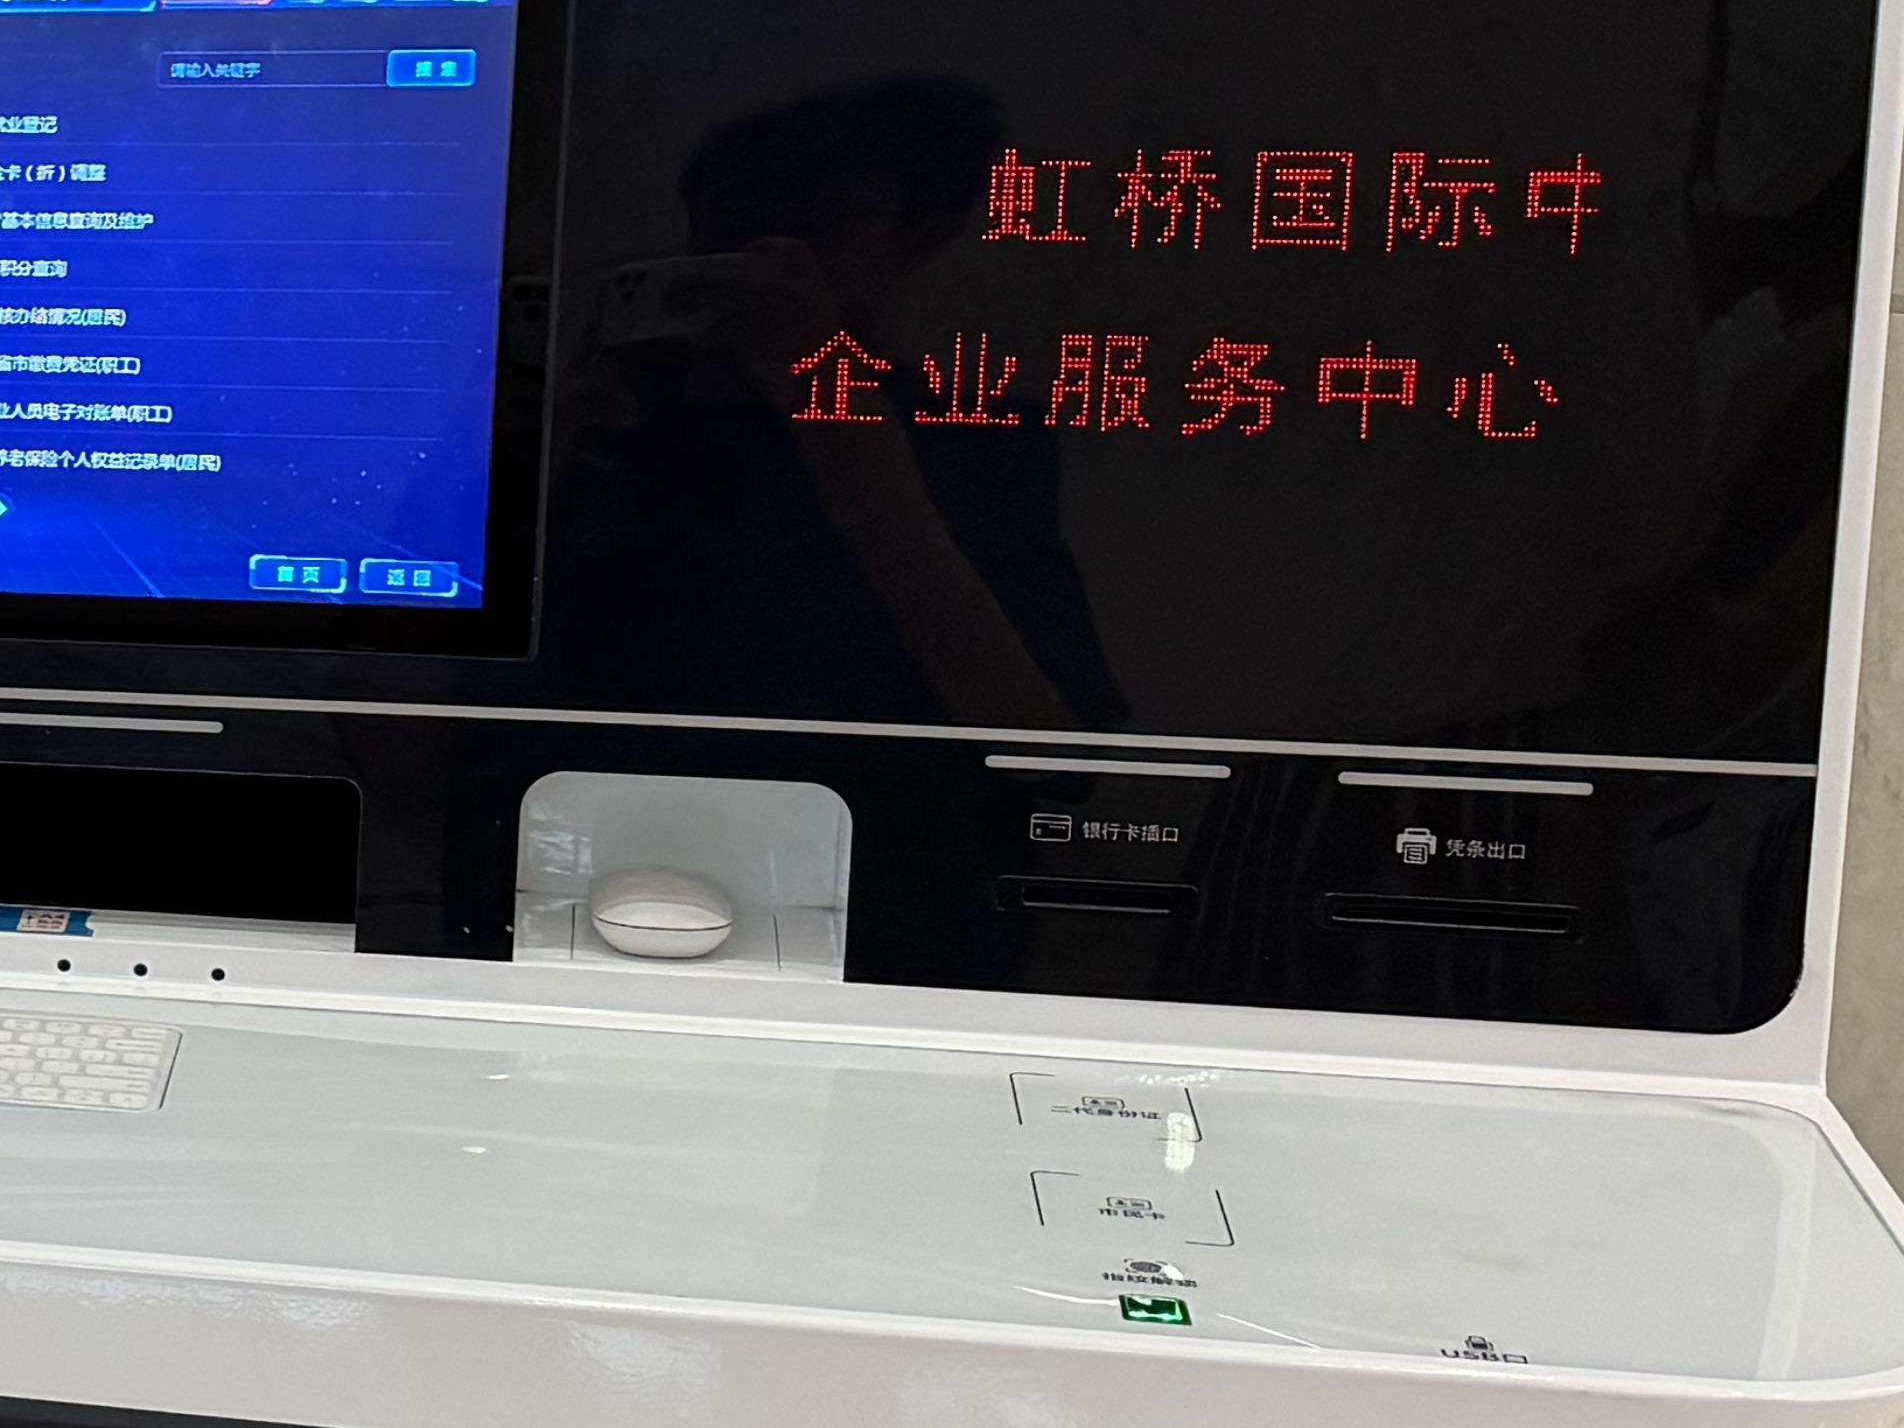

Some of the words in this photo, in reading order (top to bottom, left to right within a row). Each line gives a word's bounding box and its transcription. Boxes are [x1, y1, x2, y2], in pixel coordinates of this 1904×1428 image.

[981, 145, 1603, 255] 虹桥国际中
[791, 329, 1560, 440] 企业服务中心
[1081, 818, 1181, 846] 银行卡插口
[1444, 837, 1528, 862] 凭条出口
